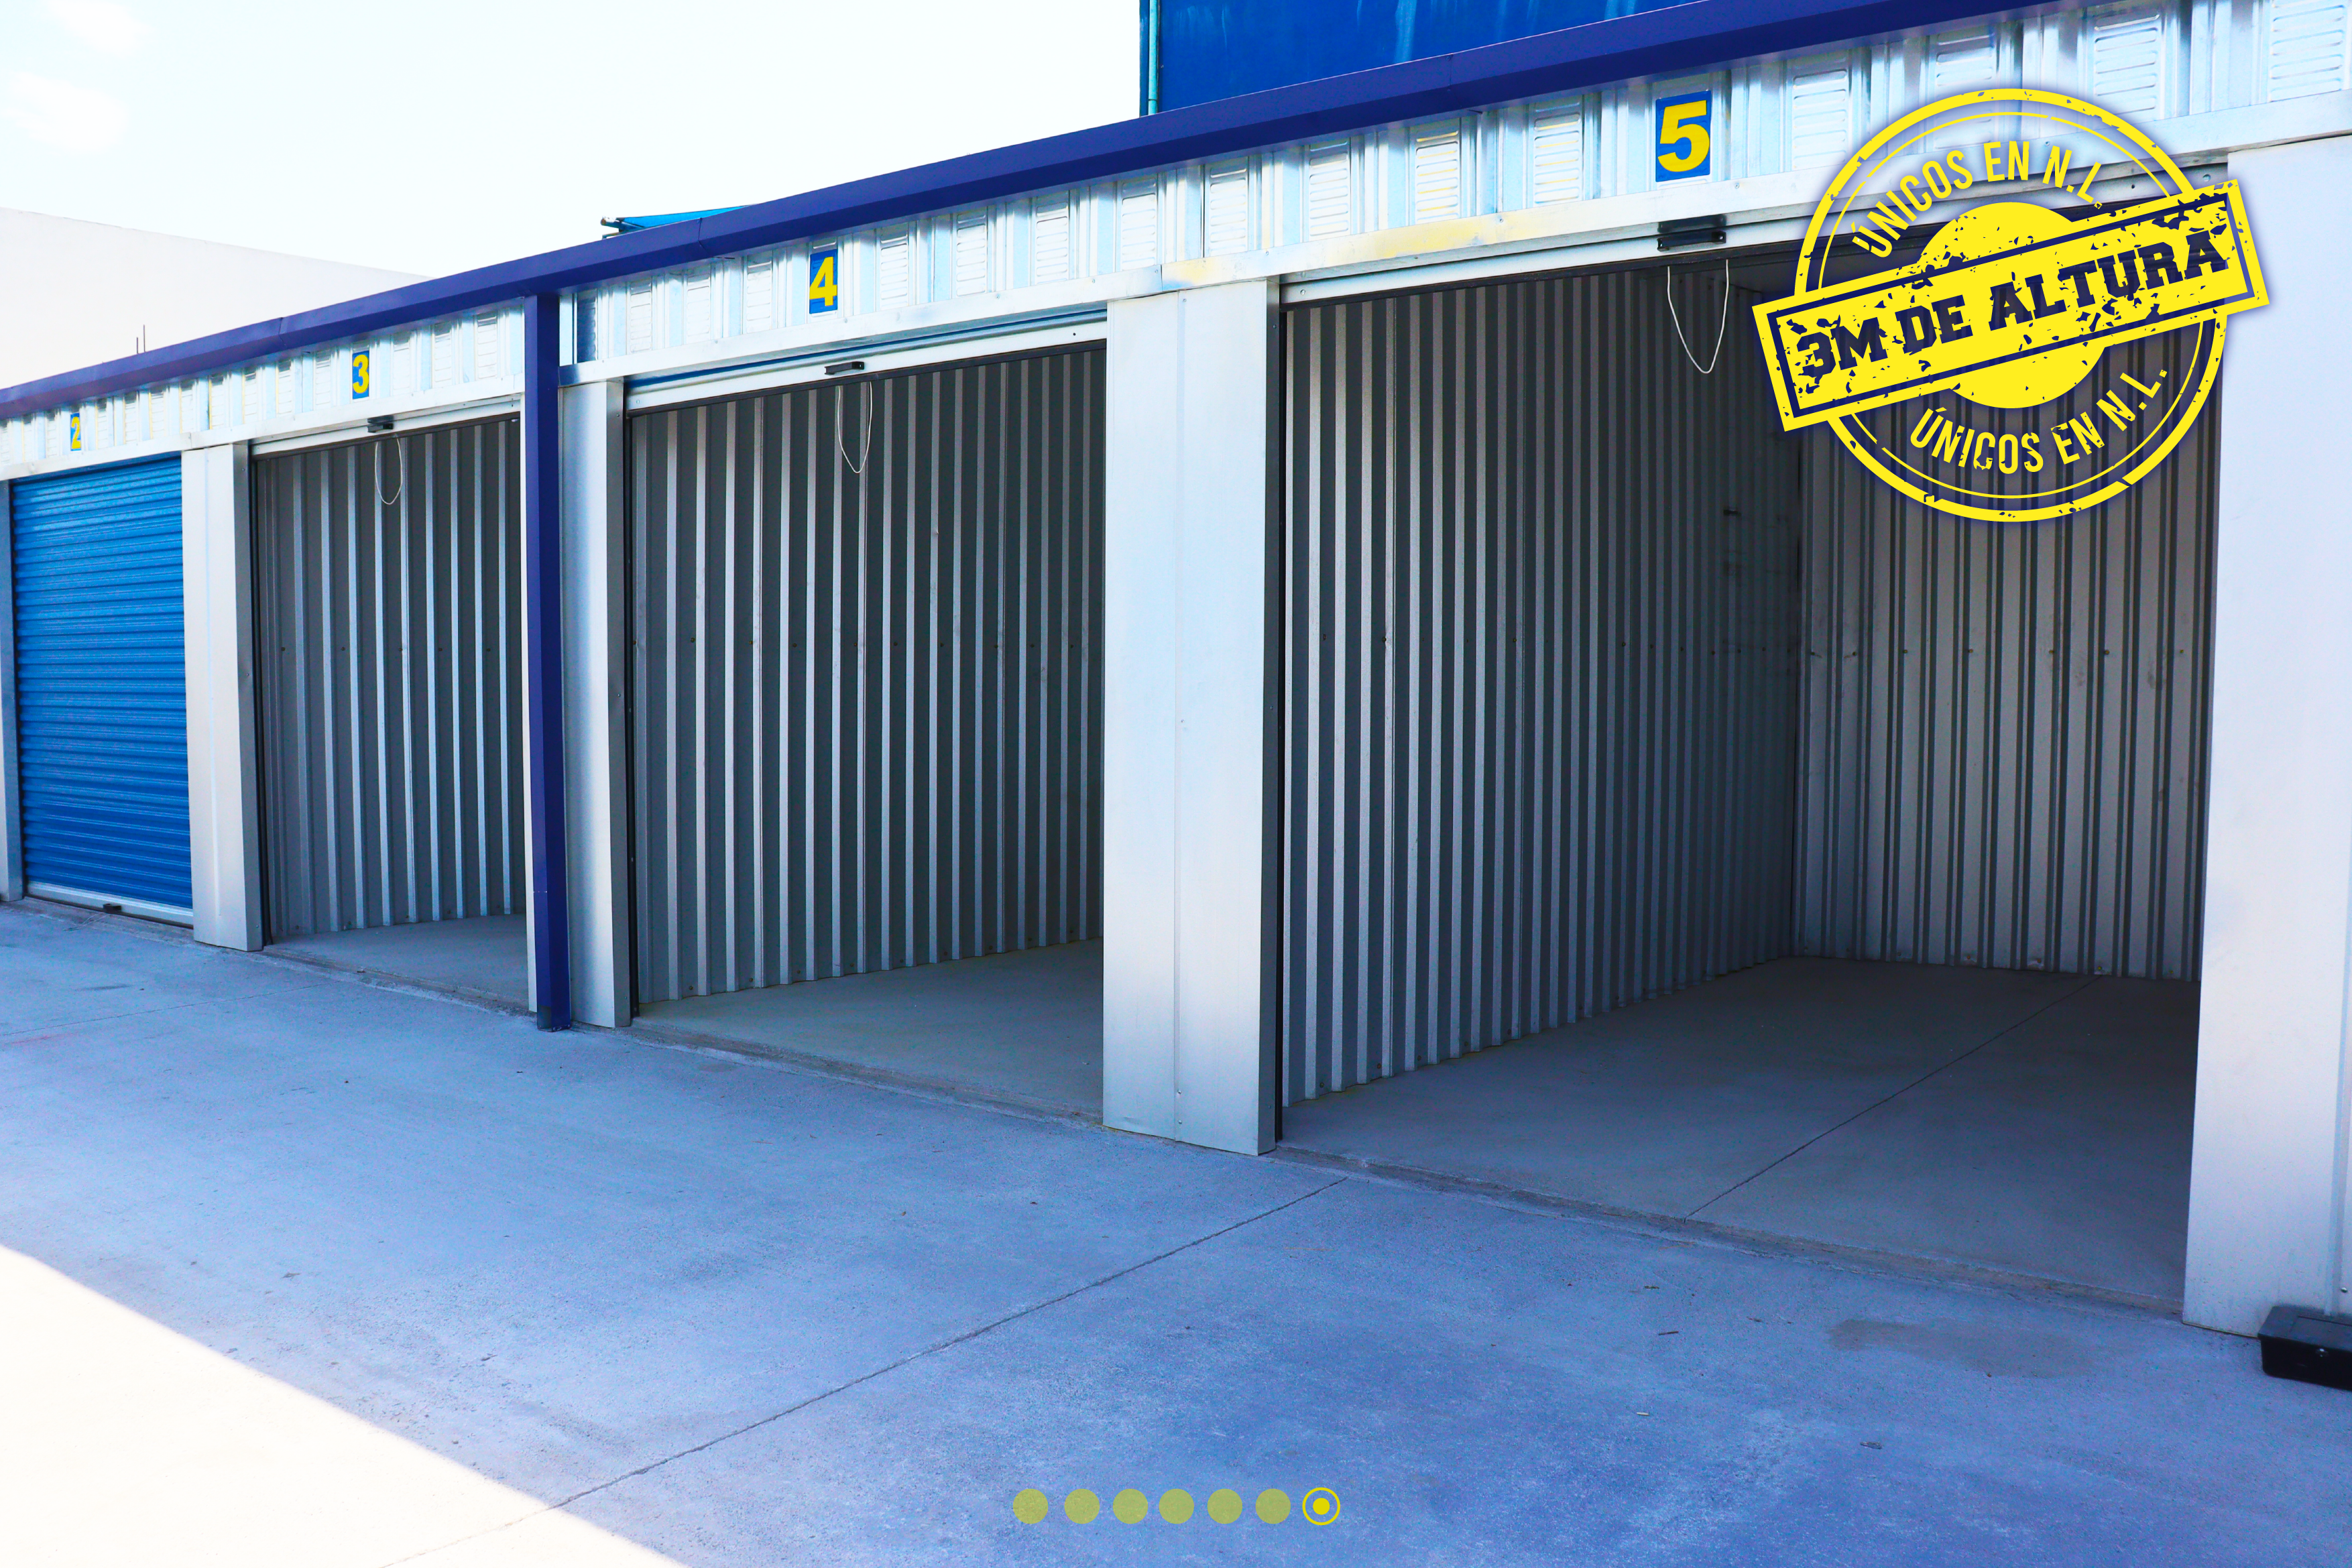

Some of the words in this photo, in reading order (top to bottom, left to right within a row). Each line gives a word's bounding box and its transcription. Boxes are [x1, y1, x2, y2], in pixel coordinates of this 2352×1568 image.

[1657, 100, 1710, 172] 5
[809, 256, 837, 306] 4
[353, 354, 369, 394] 3
[71, 416, 81, 449] 2
